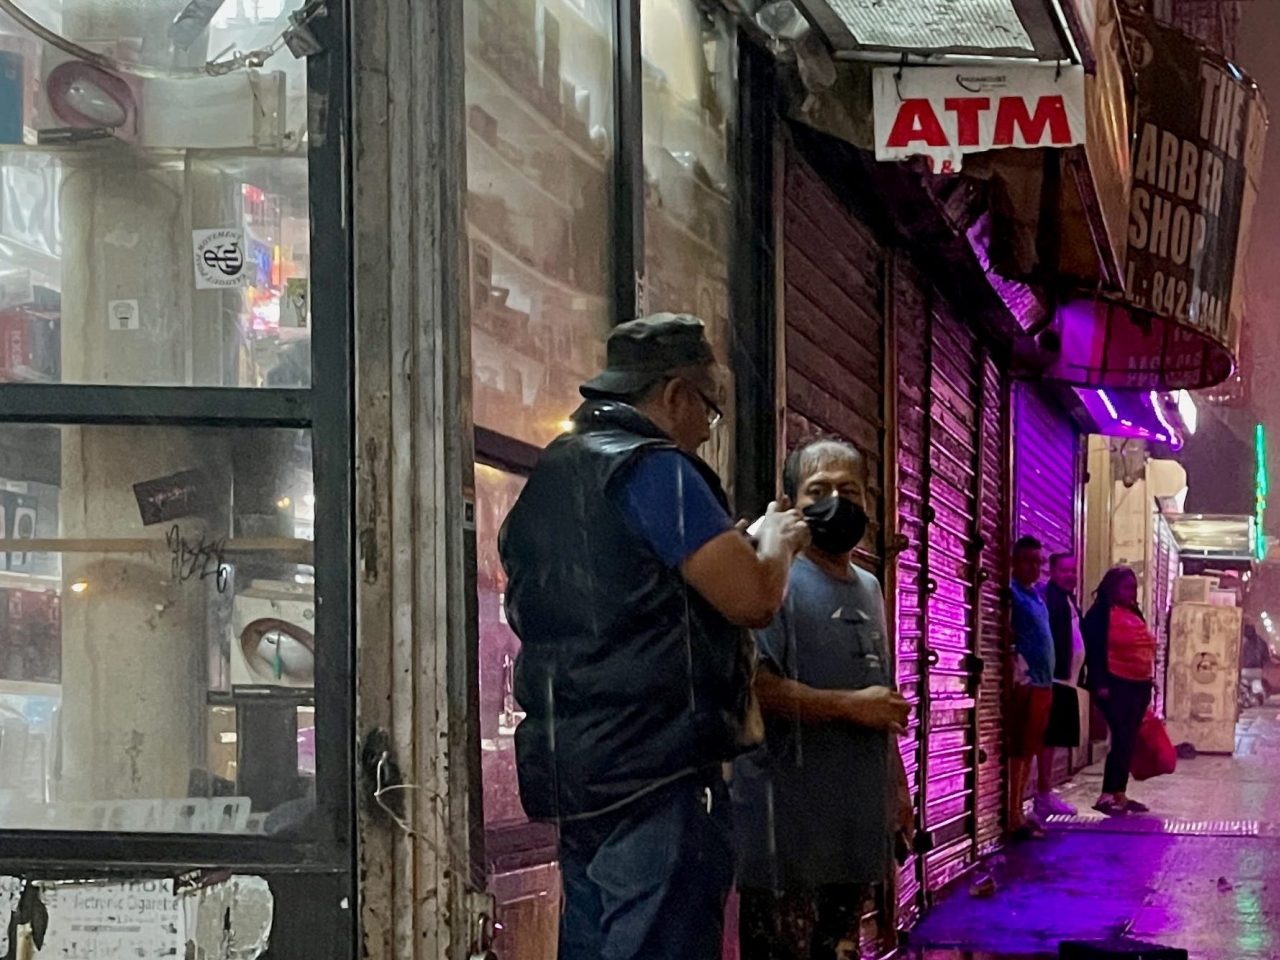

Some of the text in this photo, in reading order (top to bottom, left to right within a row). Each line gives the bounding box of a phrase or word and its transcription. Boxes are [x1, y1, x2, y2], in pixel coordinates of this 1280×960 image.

[886, 94, 1072, 147] ATM
[1200, 63, 1246, 161] THE
[1134, 122, 1225, 217] ARBER
[1128, 187, 1207, 269] SHOP
